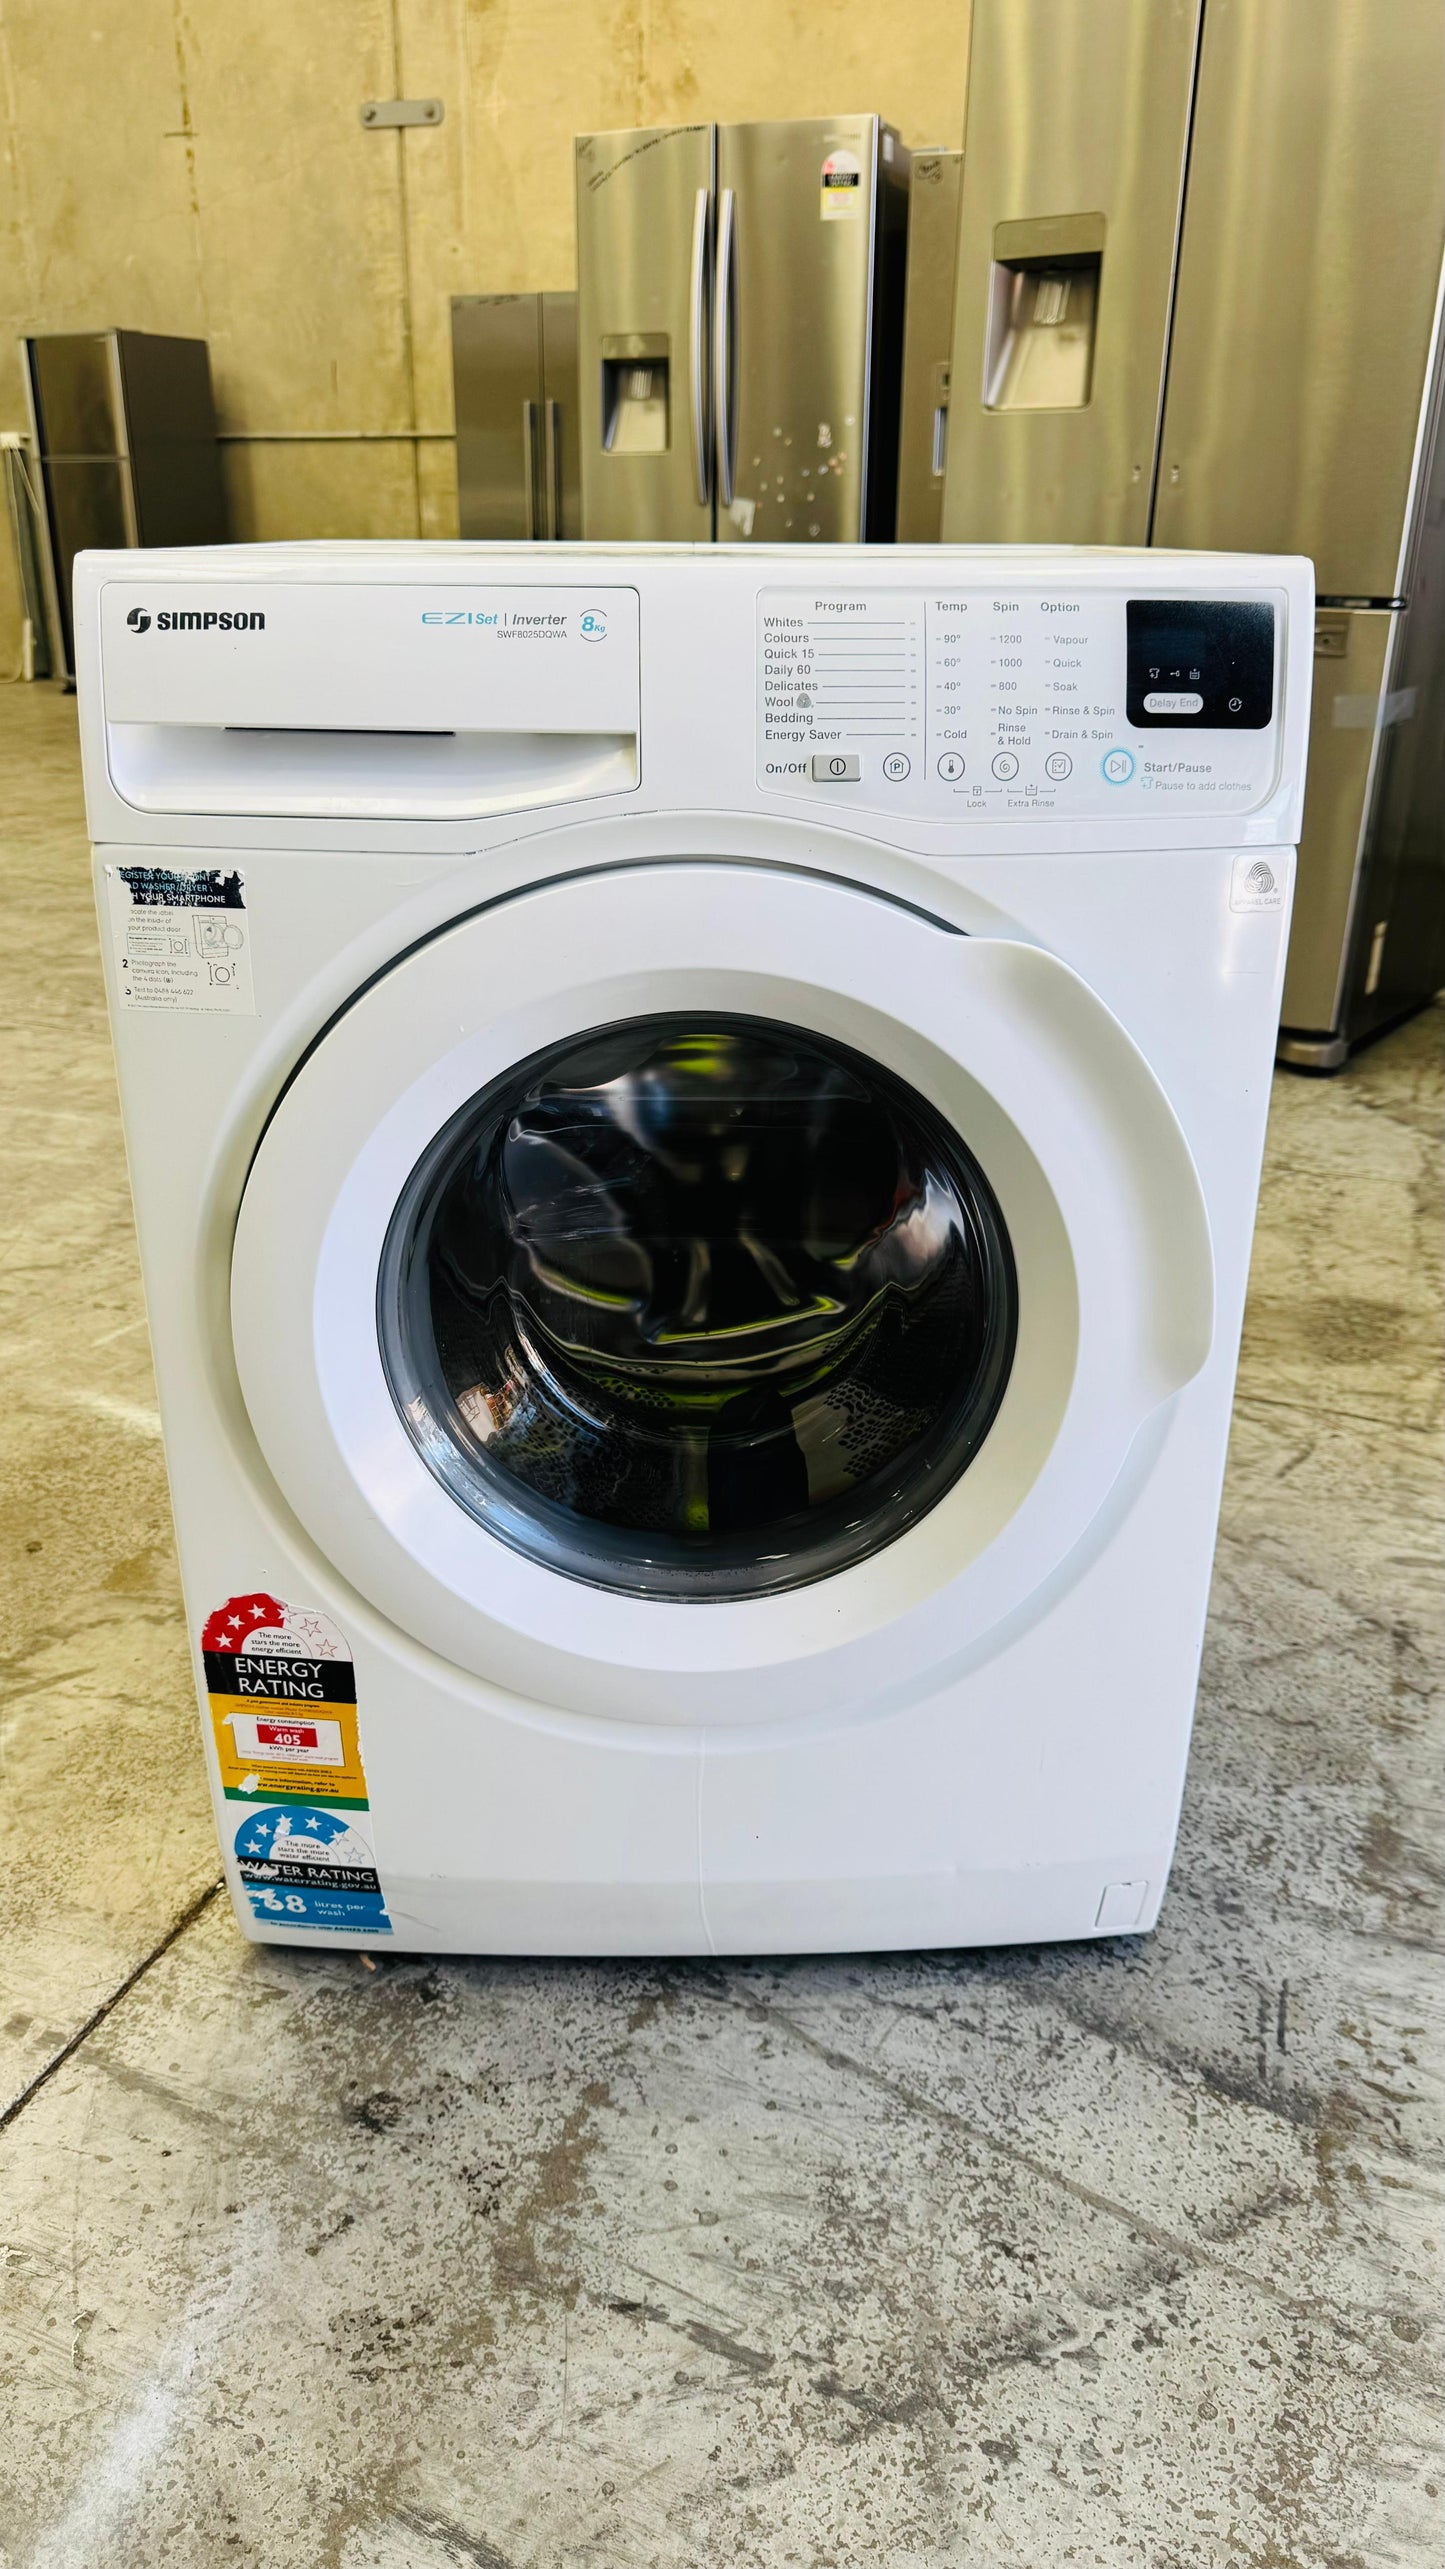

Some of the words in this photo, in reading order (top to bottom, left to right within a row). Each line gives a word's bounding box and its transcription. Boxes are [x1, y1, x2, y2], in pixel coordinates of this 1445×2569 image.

[815, 601, 867, 612] Program
[936, 602, 967, 612] Temp
[993, 602, 1019, 612] Spin
[1041, 602, 1080, 612] Option
[158, 612, 265, 630] SIMPSON
[421, 612, 472, 624] EZI
[476, 613, 499, 624] Set
[512, 614, 567, 625] Inverter
[764, 618, 803, 627] Whites
[497, 631, 567, 639] SWF8025DQWA
[764, 633, 809, 643] Colours
[999, 635, 1022, 643] 1200
[1053, 636, 1088, 646] Vapour
[764, 649, 797, 659] Quick
[802, 649, 814, 658] 15
[999, 659, 1022, 667] 1000
[1053, 659, 1082, 668] Quick
[765, 665, 793, 677] Daily
[797, 665, 811, 674] 60
[765, 681, 818, 690] Delicates
[999, 682, 1017, 690] 800
[1053, 682, 1077, 691] Soak
[765, 697, 794, 707] Wool
[1150, 698, 1176, 709] Delay
[1180, 699, 1198, 707] End
[998, 706, 1012, 715] No
[1016, 707, 1038, 716] Spin
[1052, 706, 1080, 715] Rinse
[1083, 706, 1089, 715] &
[1093, 707, 1115, 716] Spin
[765, 713, 813, 725] Bedding
[998, 723, 1026, 732] Rinse
[765, 730, 805, 742] Energy
[809, 730, 841, 740] Saver
[944, 730, 967, 739] Cold
[1052, 730, 1078, 739] Drain
[1082, 730, 1088, 738] &
[1091, 731, 1113, 740] Spin
[998, 737, 1004, 745] &
[1008, 737, 1031, 745] Hold
[766, 763, 807, 773] On/Off
[1144, 763, 1212, 773] Start/Pause
[1156, 781, 1183, 790] Pause
[1187, 782, 1195, 790] to
[1199, 782, 1215, 791] add
[1219, 782, 1251, 791] clothes
[967, 800, 986, 808] Lock
[166, 893, 226, 904] SMARTPHONE
[122, 959, 128, 968] 2
[235, 1658, 322, 1678] ENERGY
[239, 1678, 324, 1698] RATING
[274, 1734, 301, 1744] 405
[307, 1868, 374, 1882] RATING
[244, 1874, 376, 1889] www.waterrating.gov.au
[315, 1901, 343, 1909] litres
